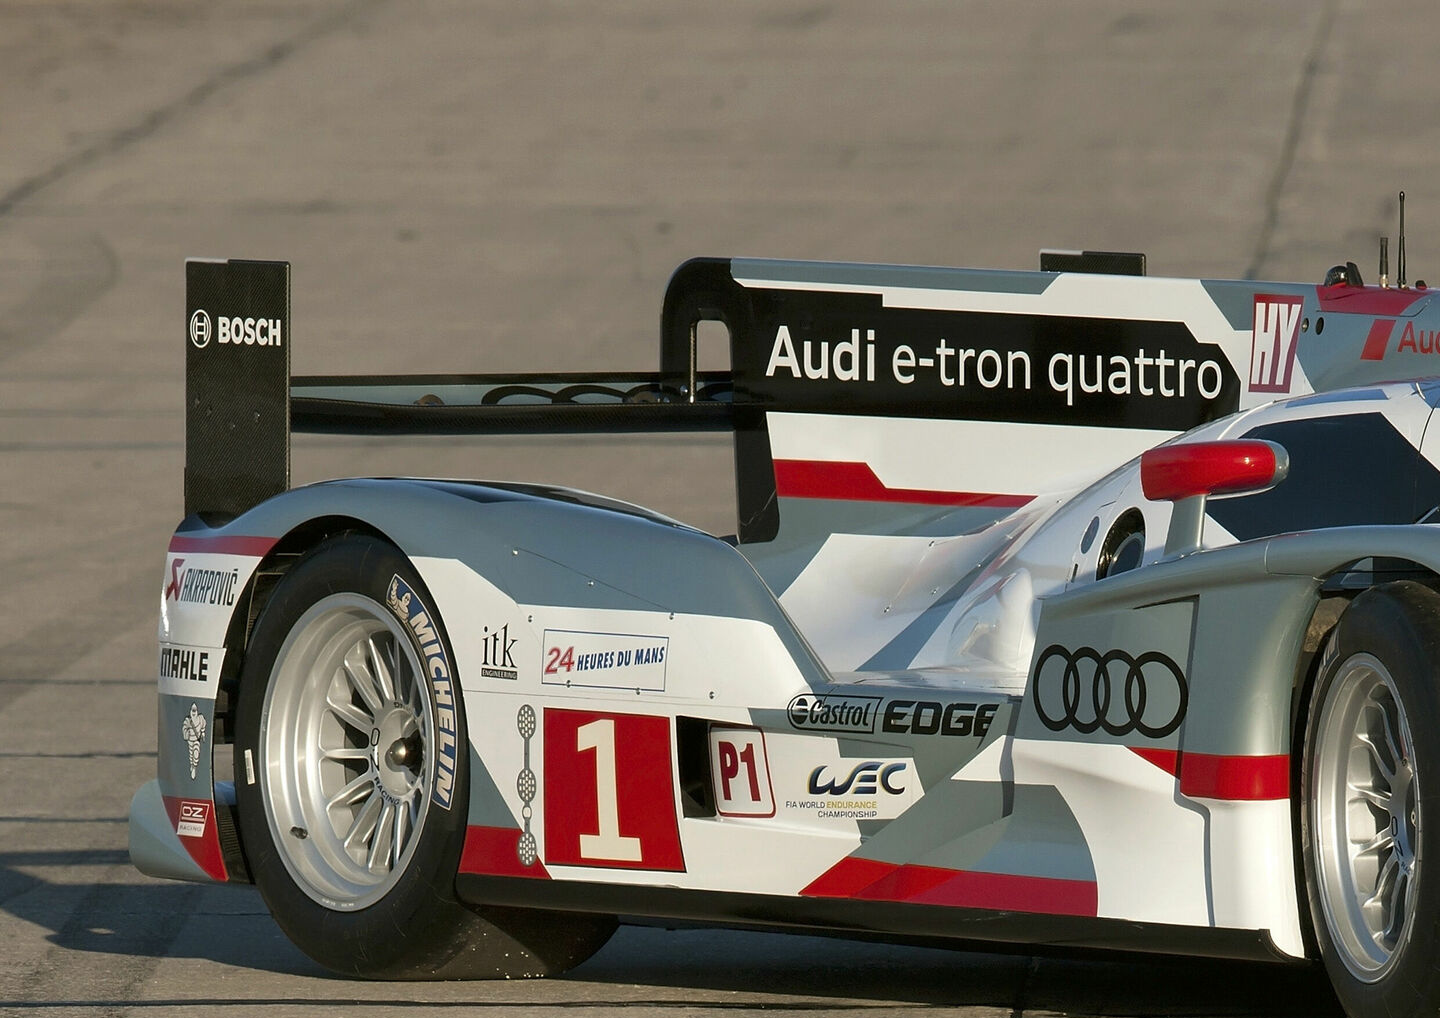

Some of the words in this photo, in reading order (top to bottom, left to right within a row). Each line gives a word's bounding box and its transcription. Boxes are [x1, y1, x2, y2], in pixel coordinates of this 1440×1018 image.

[217, 316, 282, 347] BOSCH
[1251, 302, 1302, 386] HY
[765, 325, 876, 382] Audi
[892, 338, 1032, 391] e-tron
[1048, 348, 1224, 406] quattro
[160, 647, 208, 681] MAHLE
[481, 622, 519, 668] itk
[544, 646, 576, 675] 24
[577, 651, 615, 672] HEURES
[617, 649, 633, 668] DU
[634, 646, 666, 665] MANS
[409, 609, 458, 805] MICHELIN
[806, 698, 871, 727] Castrol
[882, 699, 1000, 738] EDGE
[577, 719, 643, 862] 1
[717, 740, 762, 802] P1
[806, 761, 908, 796] WEC
[785, 801, 797, 809] FIA
[798, 801, 826, 810] WORLD
[827, 801, 877, 810] ENDURANCE
[817, 810, 878, 819] CHAMPIONSHIP
